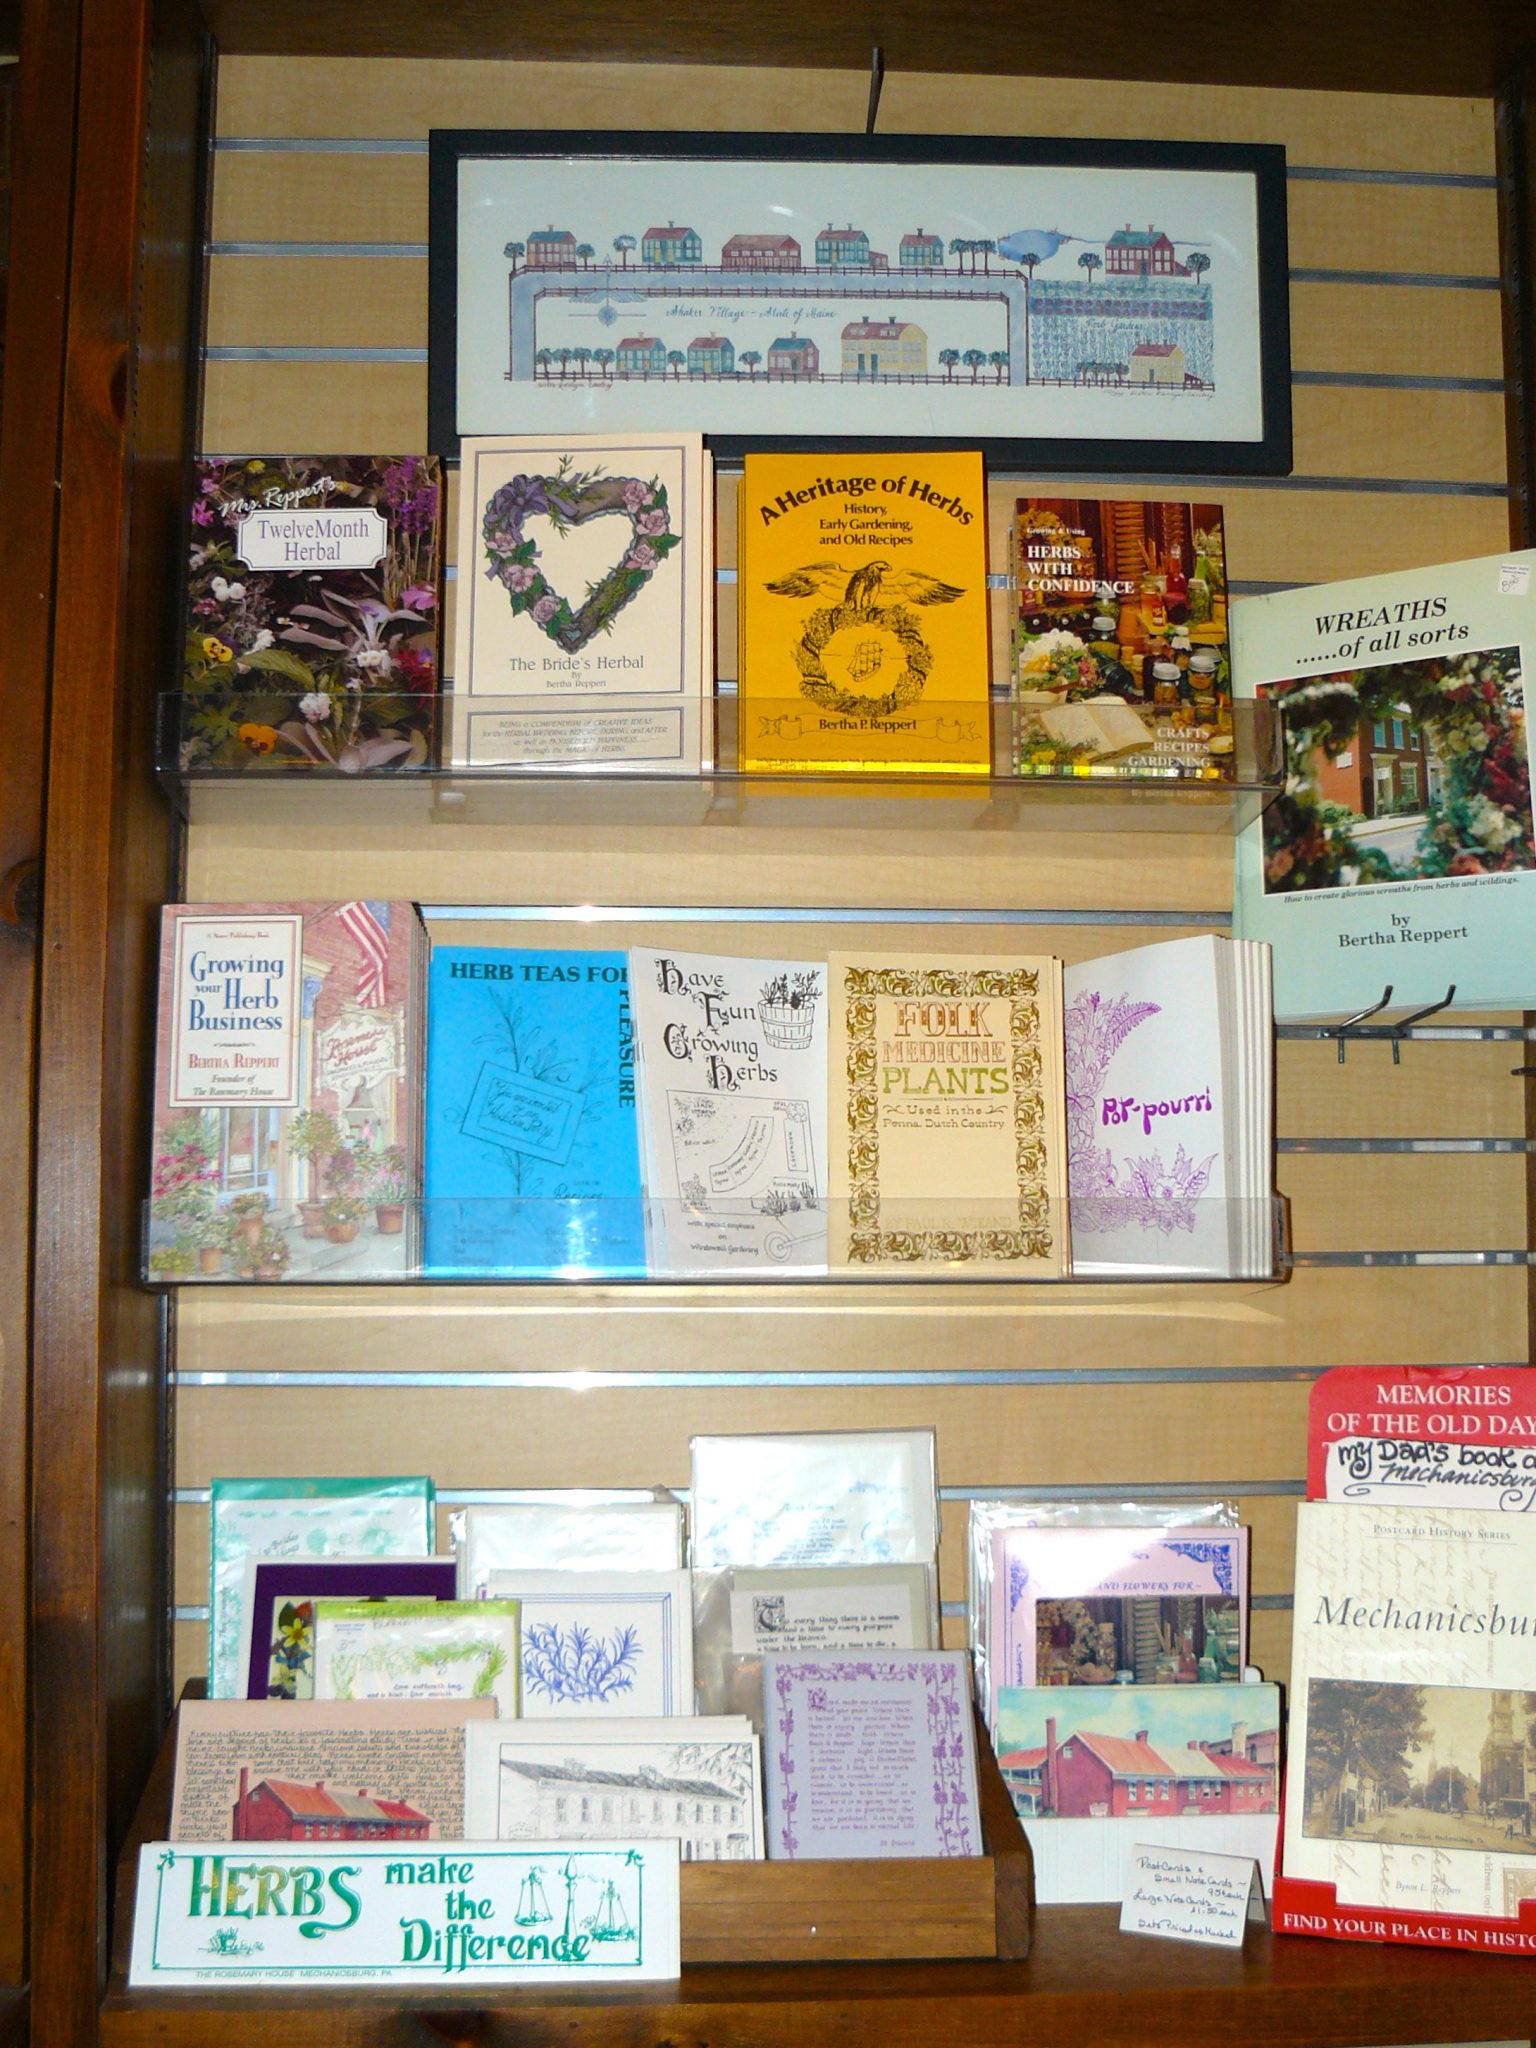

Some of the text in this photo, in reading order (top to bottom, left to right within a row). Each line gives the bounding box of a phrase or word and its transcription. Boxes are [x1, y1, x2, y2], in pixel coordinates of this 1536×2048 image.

[710, 305, 745, 323] Village
[793, 308, 803, 325] of
[218, 475, 336, 517] Mrs. Reppert's
[759, 476, 974, 527] A Heritage of Herbs
[844, 504, 887, 516] History,
[258, 518, 369, 539] Twelve Month
[819, 519, 913, 532] Early Gardening,
[284, 541, 341, 561] Herbal
[819, 534, 913, 548] and Old Recipes
[1027, 545, 1081, 559] HERBS
[1027, 562, 1073, 575] WITH
[1027, 579, 1136, 594] CONFIDENCE
[1315, 597, 1448, 636] WREATHS
[1369, 630, 1401, 653] all
[1407, 624, 1470, 647] sorts
[510, 655, 644, 670] The Bride's Herbal
[546, 680, 607, 689] Bertha Reppert
[819, 718, 917, 734] Bertha P. Reppert
[1156, 727, 1210, 739] CRAFTS
[1153, 742, 1210, 753] RECIPES
[1127, 755, 1211, 767] GARDENING
[1304, 893, 1312, 902] to
[1313, 891, 1340, 901] create
[1341, 888, 1376, 900] glorious
[1376, 885, 1412, 896] wreaths
[1412, 883, 1434, 893] from
[1436, 880, 1460, 891] herbs
[1461, 878, 1478, 888] and
[1479, 876, 1519, 889] wildings.
[1391, 913, 1410, 928] by
[1338, 925, 1468, 948] Bertha Reppert
[190, 951, 284, 982] Growing
[451, 962, 513, 981] HERB
[520, 964, 580, 983] TEAS
[654, 958, 725, 996] Have
[195, 978, 279, 1009] your Herb
[188, 999, 282, 1030] Business
[691, 989, 756, 1036] Fun
[894, 1000, 993, 1038] FOLK
[663, 1022, 758, 1062] Growing
[882, 1041, 1006, 1063] MEDICINE
[212, 1073, 256, 1084] Founder of
[706, 1054, 778, 1091] Herbs
[882, 1067, 1010, 1095] PLANTS
[193, 1087, 274, 1098] The Rosemary House
[907, 1104, 982, 1115] Used in the
[882, 1118, 1006, 1130] Penna. Dutch Country
[1377, 1384, 1511, 1405] MEMORIES
[1327, 1412, 1362, 1432] OF
[1367, 1413, 1420, 1434] THE
[1427, 1414, 1481, 1435] OLD
[1377, 1440, 1450, 1464] Dad's
[1458, 1445, 1517, 1469] book
[1123, 1581, 1168, 1591] FLOWERS
[819, 1615, 838, 1625] thing
[384, 1855, 475, 1886] make
[187, 1854, 363, 1939] HERBS
[445, 1889, 496, 1921] the
[1282, 1912, 1328, 1931] FIND
[1333, 1918, 1387, 1936] YOUR
[1391, 1923, 1452, 1941] PLACE
[1456, 1927, 1478, 1943] IN
[400, 1916, 592, 1974] Difference
[196, 1970, 213, 1978] THE
[214, 1969, 264, 1978] ROSEMARY
[265, 1969, 295, 1978] HOUSE
